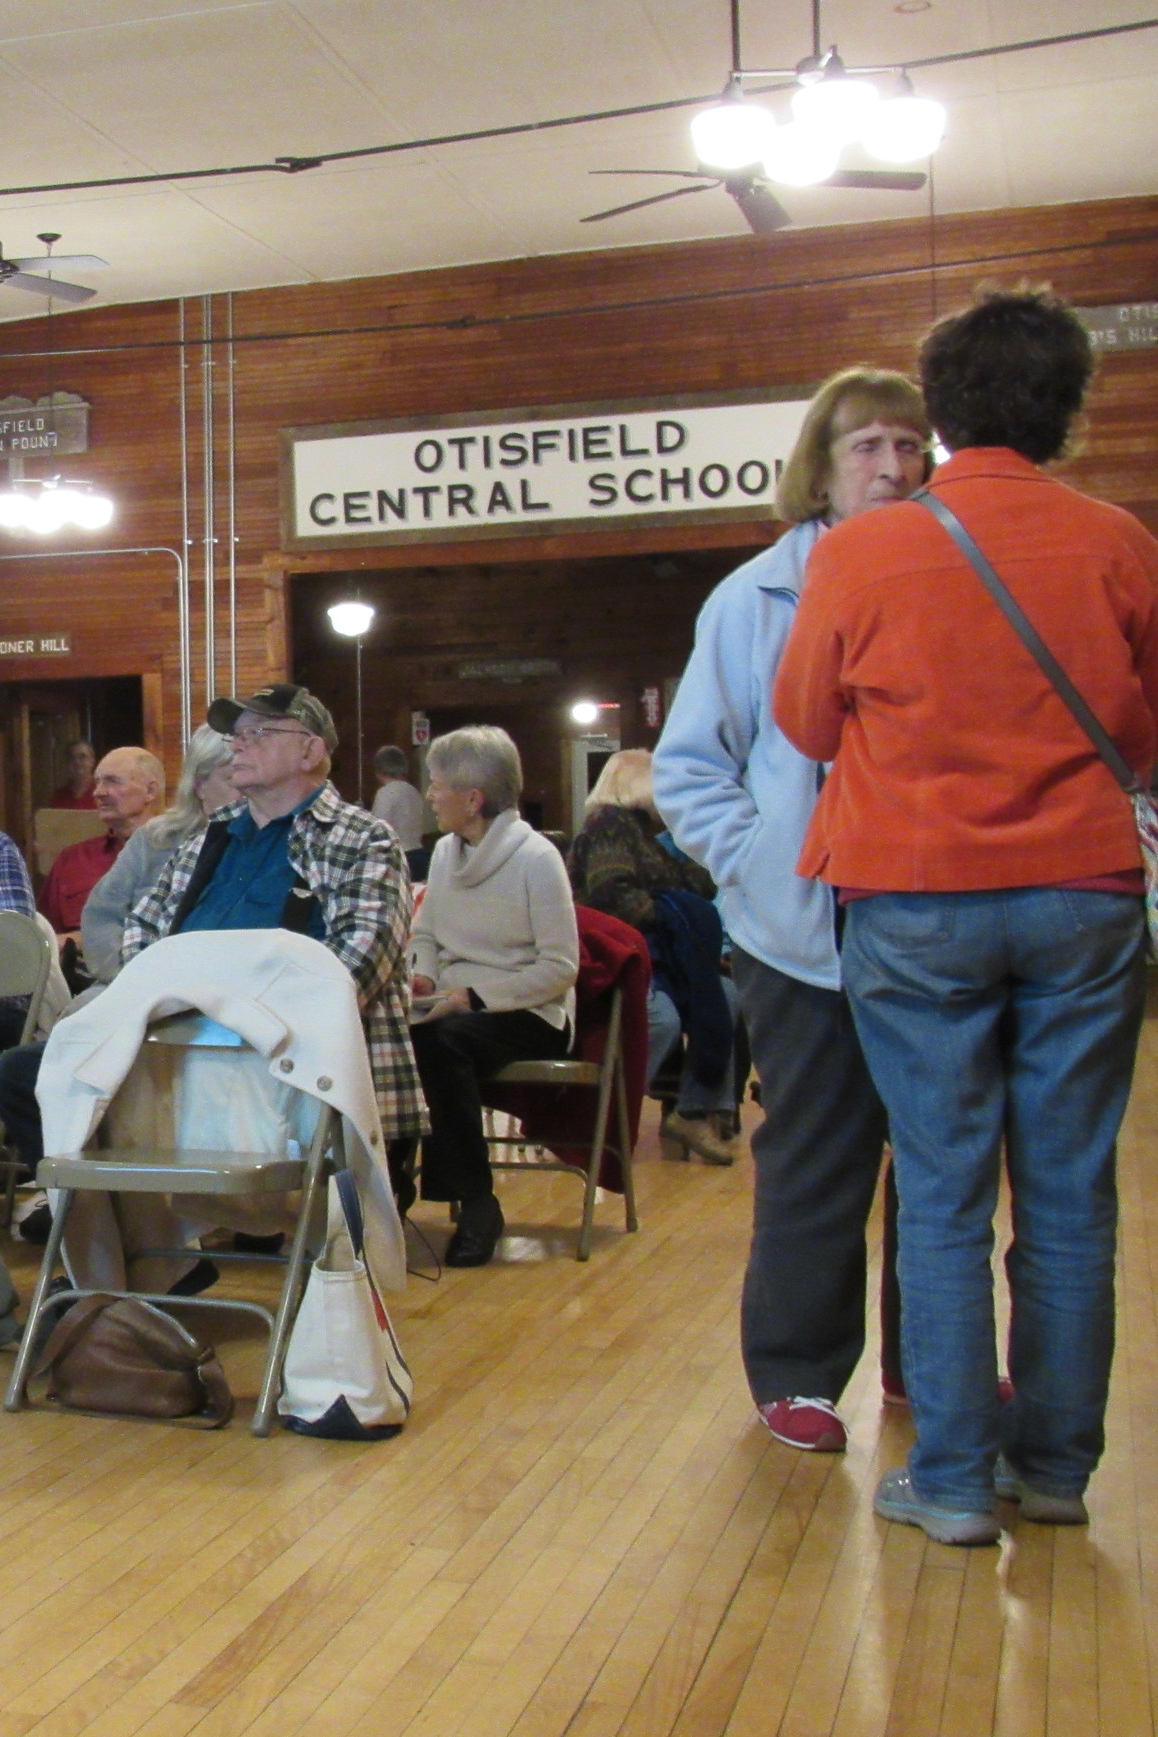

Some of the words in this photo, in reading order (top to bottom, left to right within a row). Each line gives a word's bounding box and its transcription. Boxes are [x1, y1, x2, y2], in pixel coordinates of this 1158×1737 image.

[413, 420, 689, 474] OTISFIELD
[309, 478, 550, 527] CENTRAL
[41, 638, 71, 652] HILL
